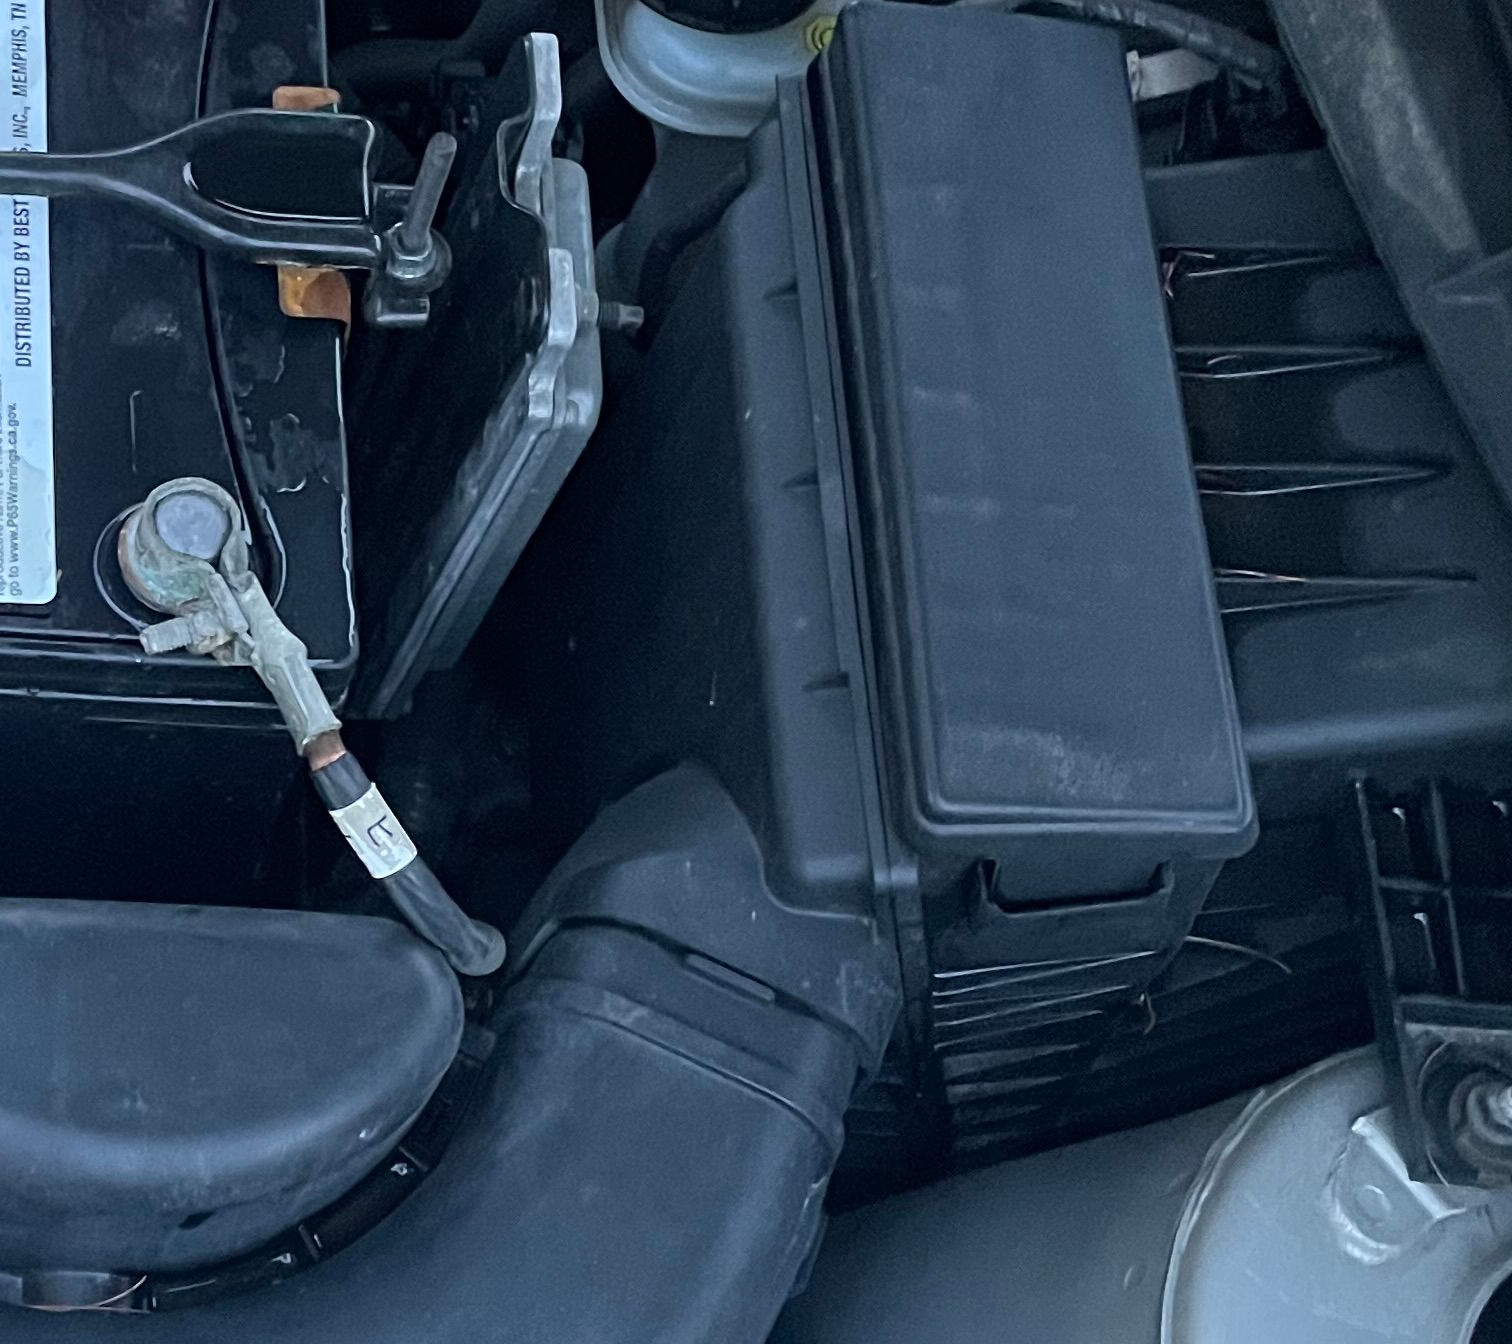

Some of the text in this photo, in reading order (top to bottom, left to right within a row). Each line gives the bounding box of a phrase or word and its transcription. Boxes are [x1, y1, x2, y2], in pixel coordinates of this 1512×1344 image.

[10, 2, 27, 20] TN
[11, 25, 27, 96] MEMPHIS,
[12, 198, 31, 367] DISTRIBUTED BY BEST
